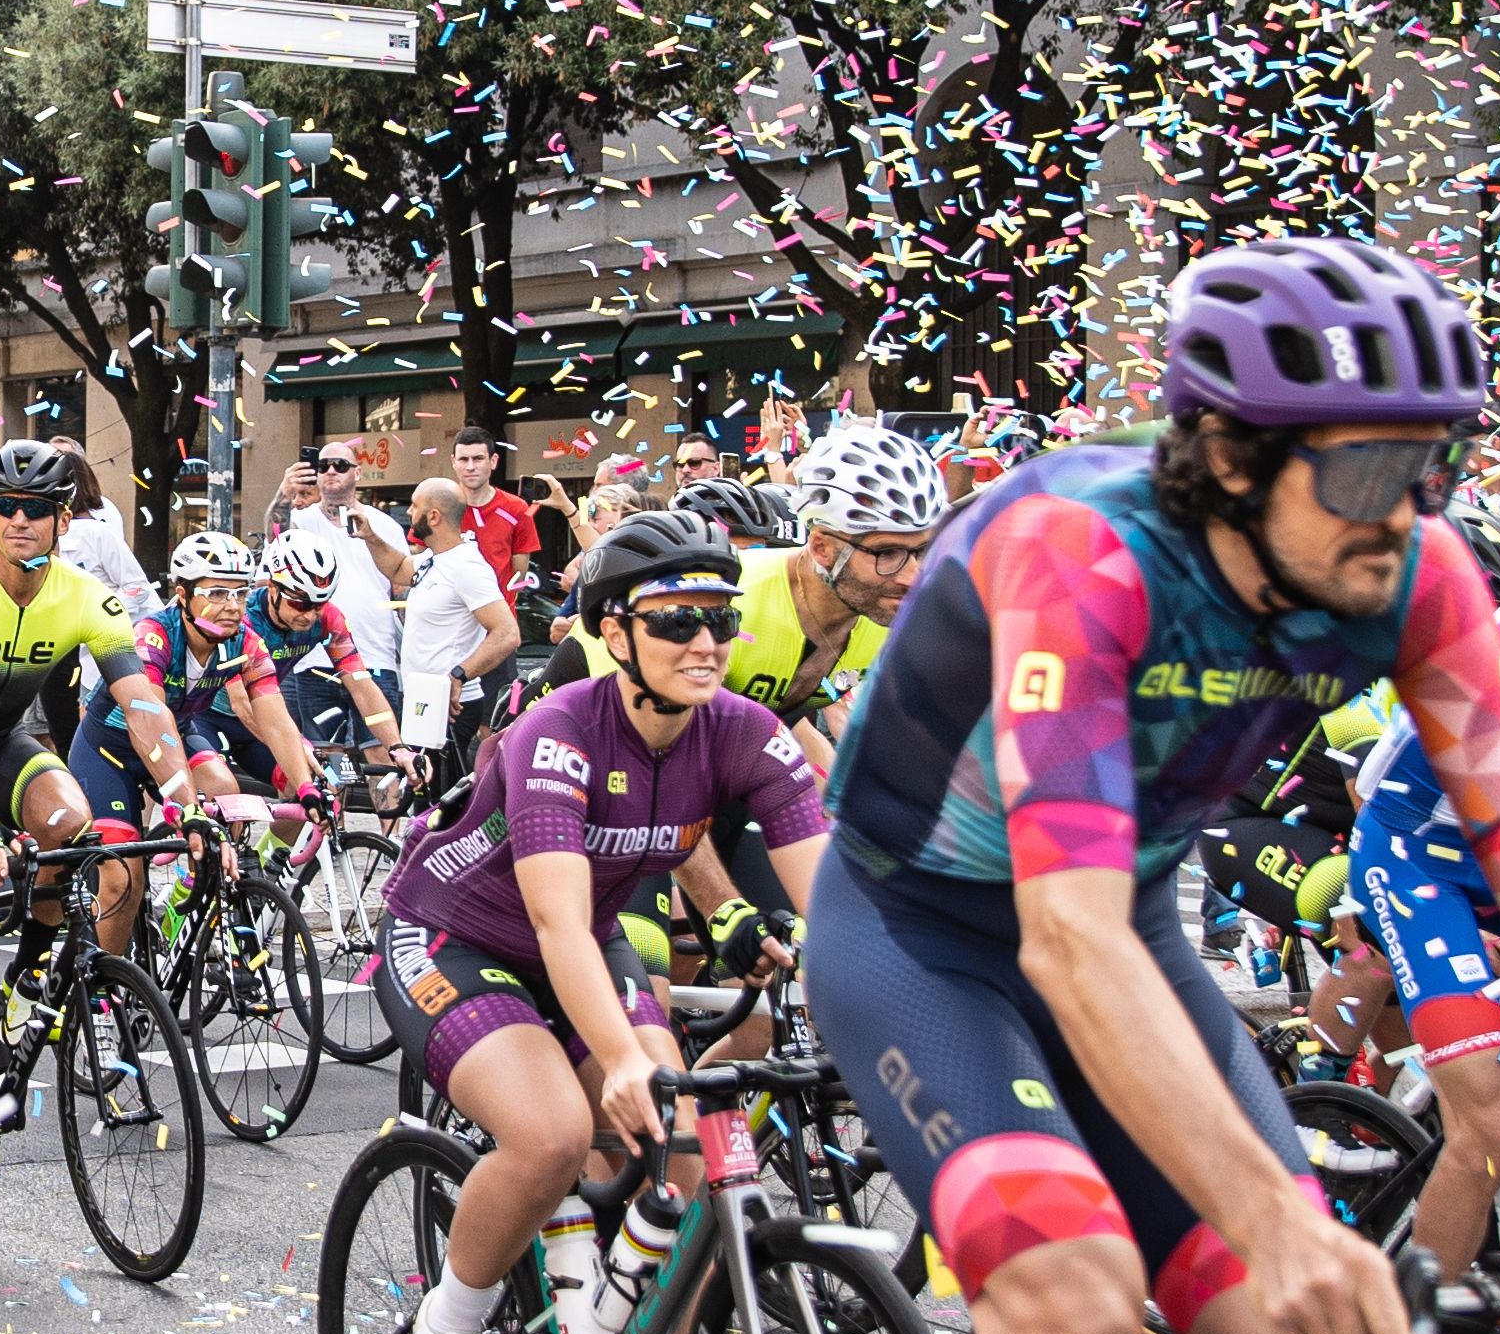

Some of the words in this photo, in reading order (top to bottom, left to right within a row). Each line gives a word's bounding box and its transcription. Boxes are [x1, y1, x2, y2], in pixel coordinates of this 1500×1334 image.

[531, 737, 592, 786] BICI
[1365, 865, 1422, 999] Groupama
[729, 1131, 753, 1151] 26
